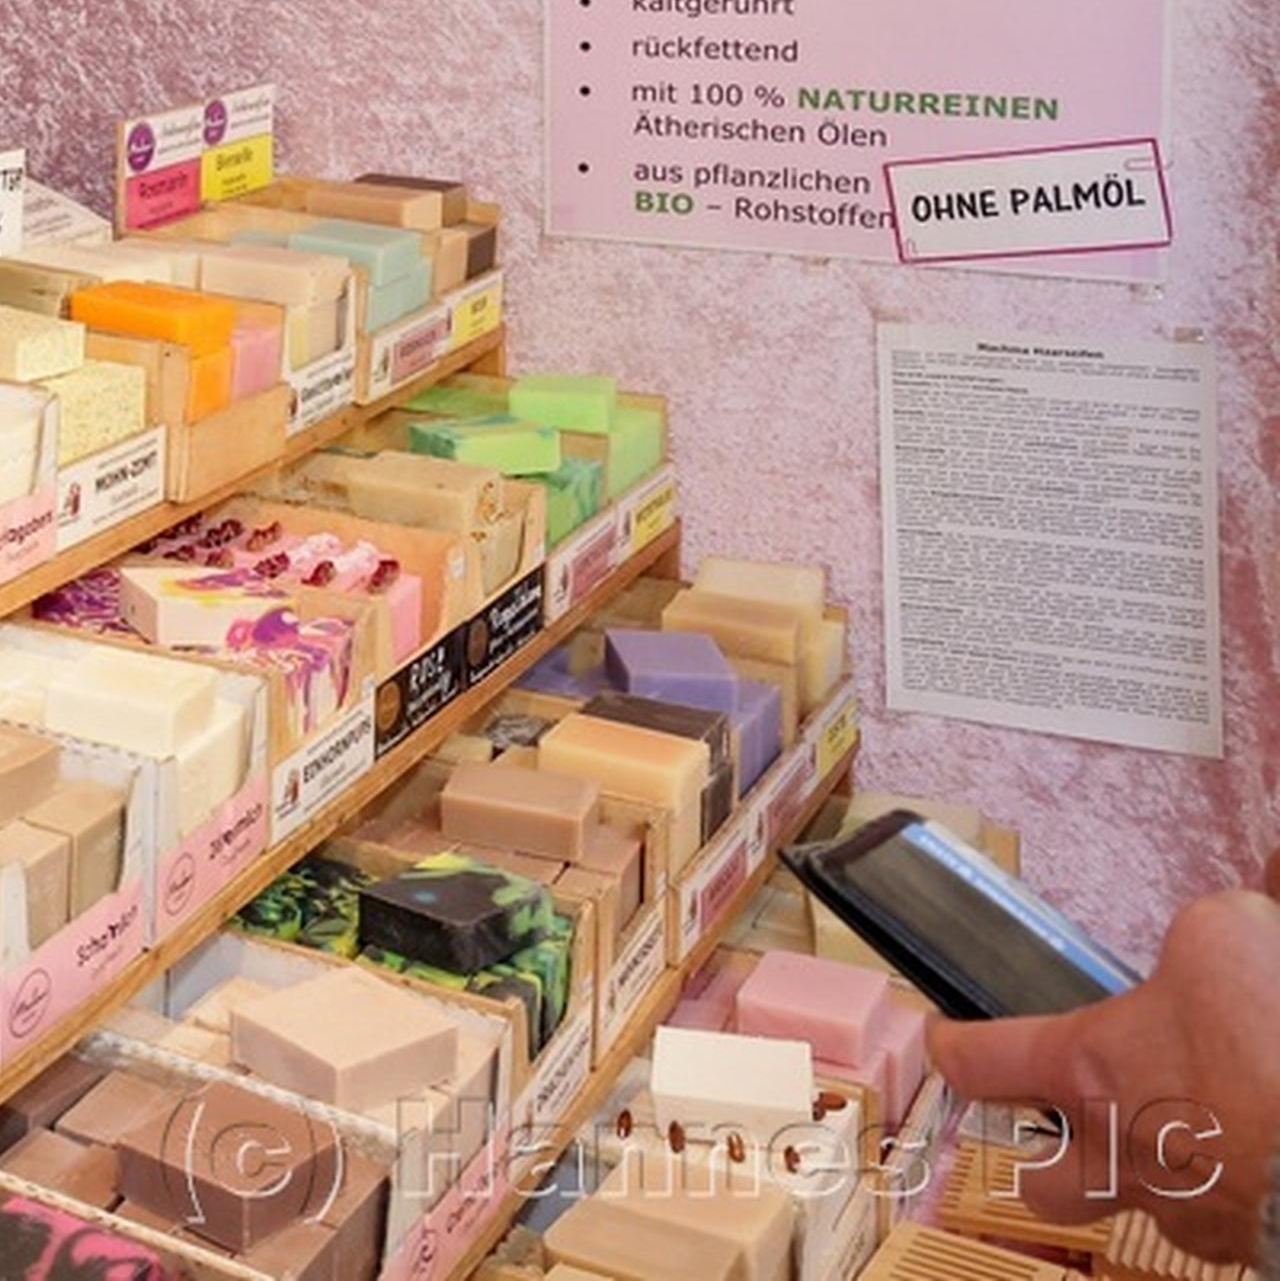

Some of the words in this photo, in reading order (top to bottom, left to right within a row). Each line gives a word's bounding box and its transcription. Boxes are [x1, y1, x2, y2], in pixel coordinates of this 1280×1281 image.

[631, 36, 799, 64] rückfettend
[631, 83, 678, 106] mit
[690, 84, 744, 108] 100
[754, 86, 786, 109] %
[797, 86, 1060, 121] NATURREINEN
[634, 113, 807, 145] Ätherischen
[817, 114, 888, 149] Ölen
[633, 163, 684, 186] aus
[694, 162, 871, 196] pflanzlichen
[634, 190, 695, 216] BIO
[734, 197, 897, 231] Rohstoffen
[910, 187, 1001, 224] OHNE
[1011, 172, 1146, 216] PALMÖL
